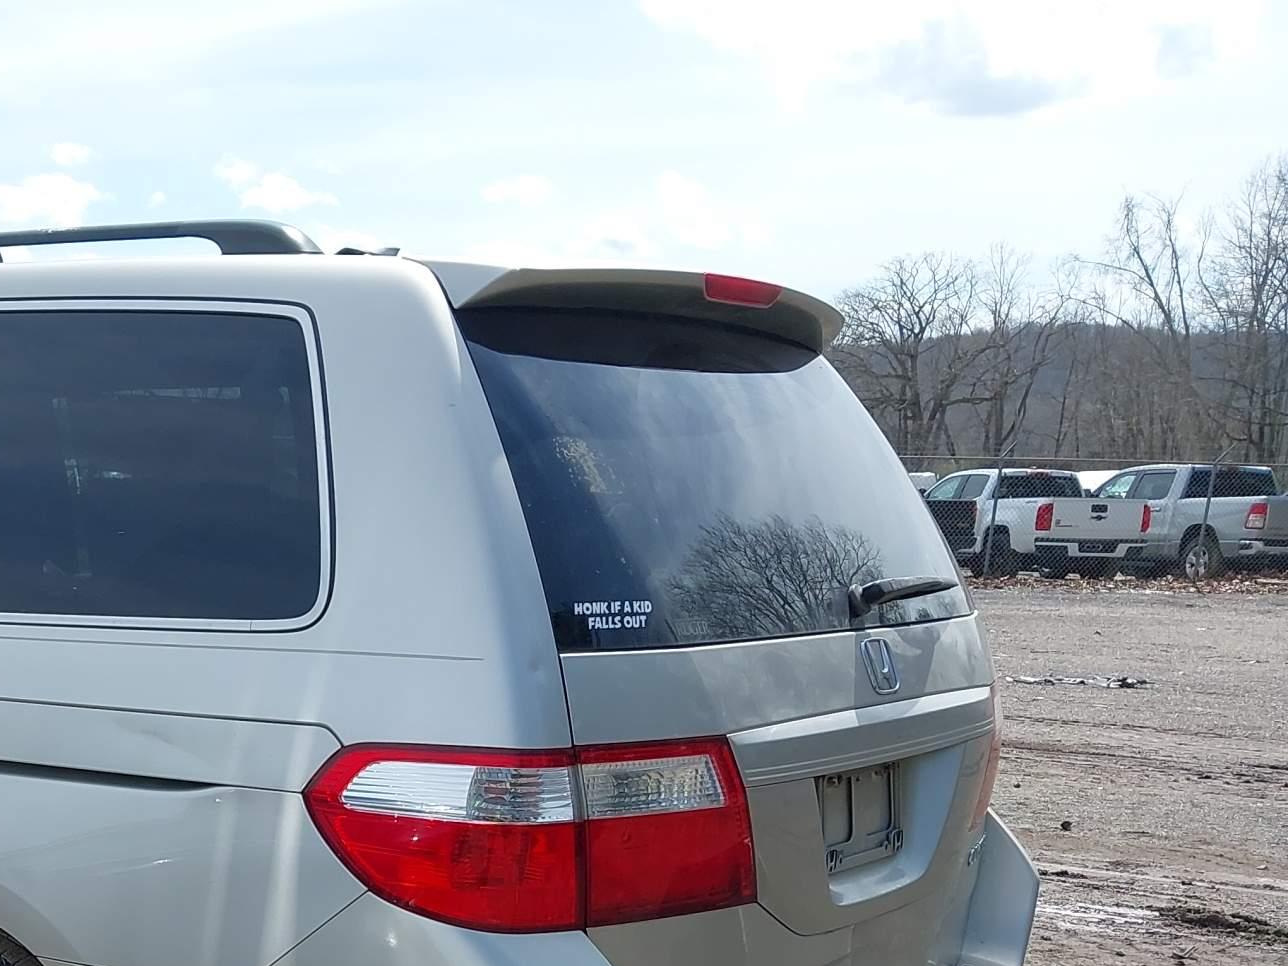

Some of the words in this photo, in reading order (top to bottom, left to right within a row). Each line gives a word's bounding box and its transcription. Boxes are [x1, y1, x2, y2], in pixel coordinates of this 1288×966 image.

[573, 602, 609, 615] HONK
[611, 601, 621, 613] IF
[623, 601, 632, 613] A
[632, 601, 652, 613] KID
[588, 616, 622, 630] FALLS
[623, 615, 647, 628] OUT
